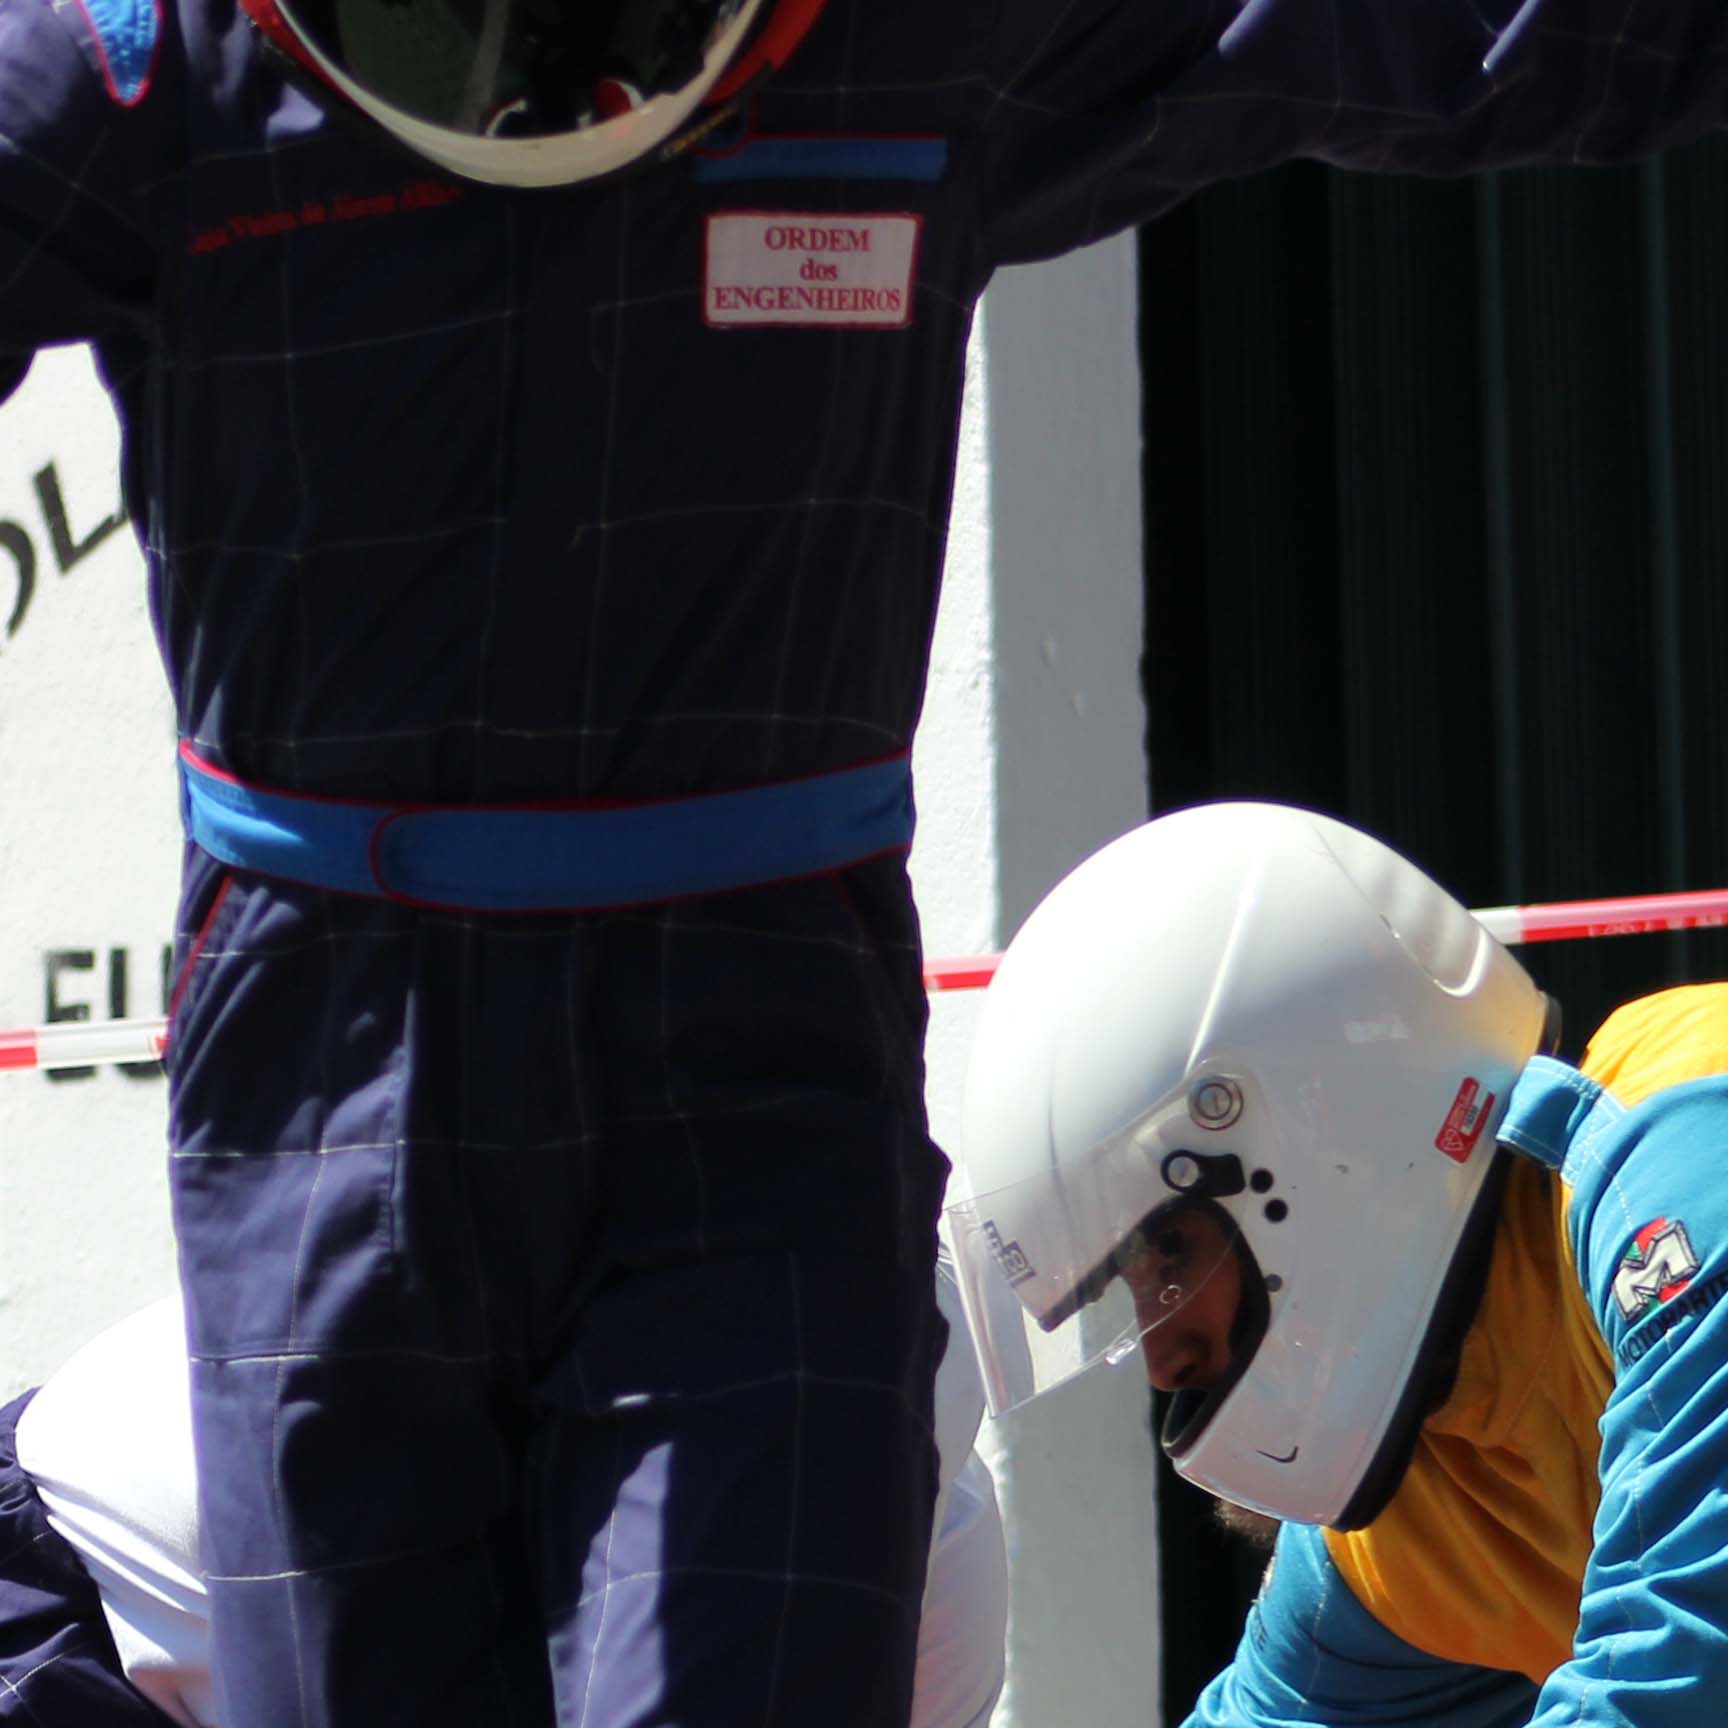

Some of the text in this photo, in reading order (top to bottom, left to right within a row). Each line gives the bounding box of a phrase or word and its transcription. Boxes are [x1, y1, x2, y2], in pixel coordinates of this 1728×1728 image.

[765, 227, 871, 252] ORDEM
[799, 258, 839, 281] dos
[713, 286, 901, 312] ENGENHEIROS
